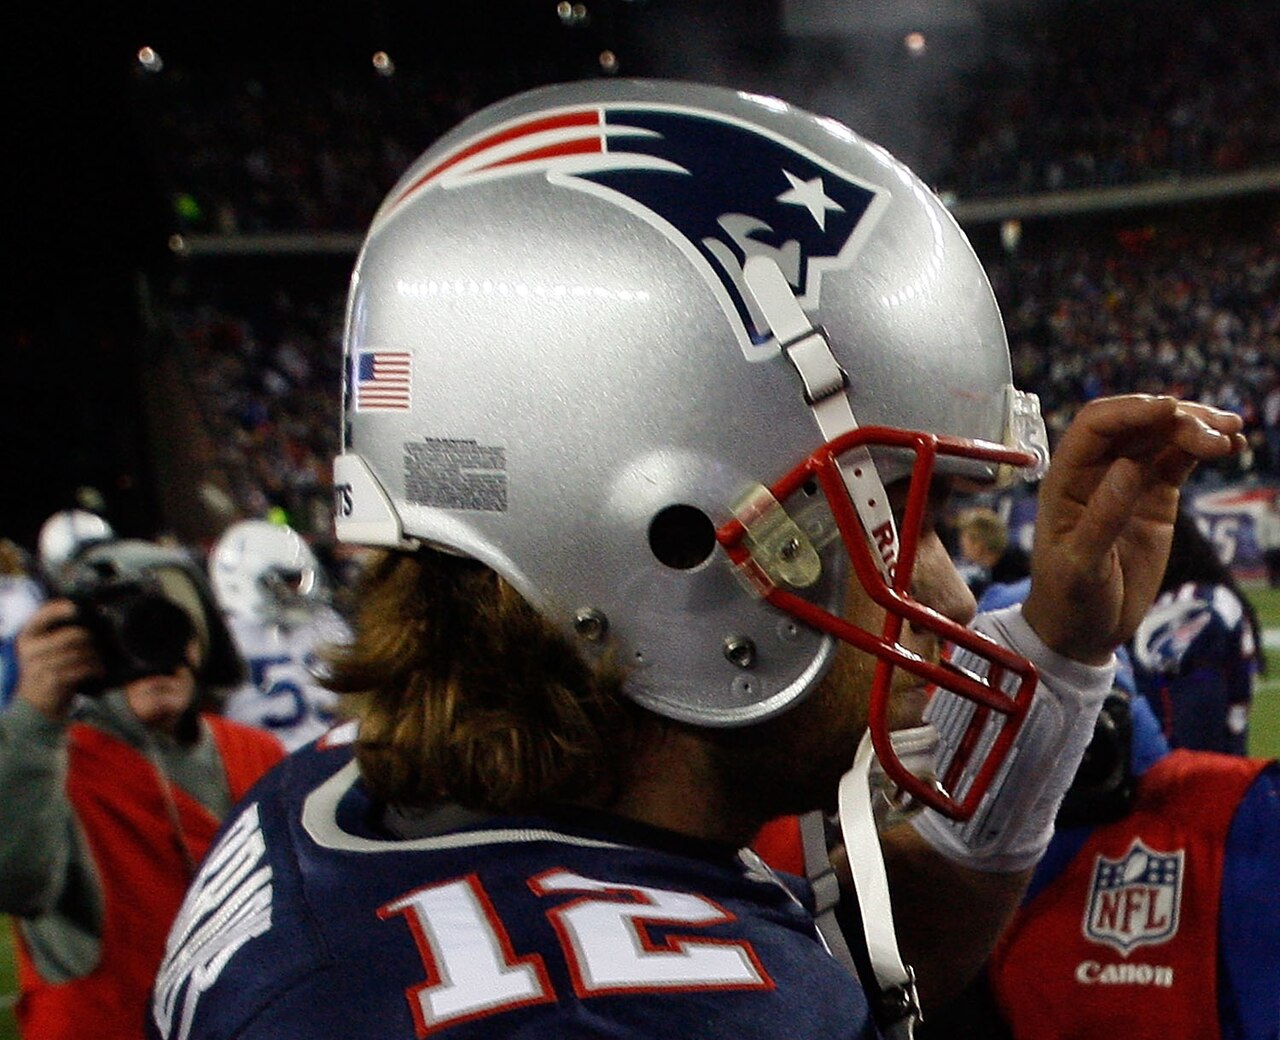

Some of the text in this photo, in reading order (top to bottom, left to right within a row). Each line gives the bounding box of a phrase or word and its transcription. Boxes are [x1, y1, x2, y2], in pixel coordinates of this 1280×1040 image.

[1096, 884, 1167, 934] NFL
[375, 866, 777, 1040] 12
[1074, 959, 1174, 989] Canon
